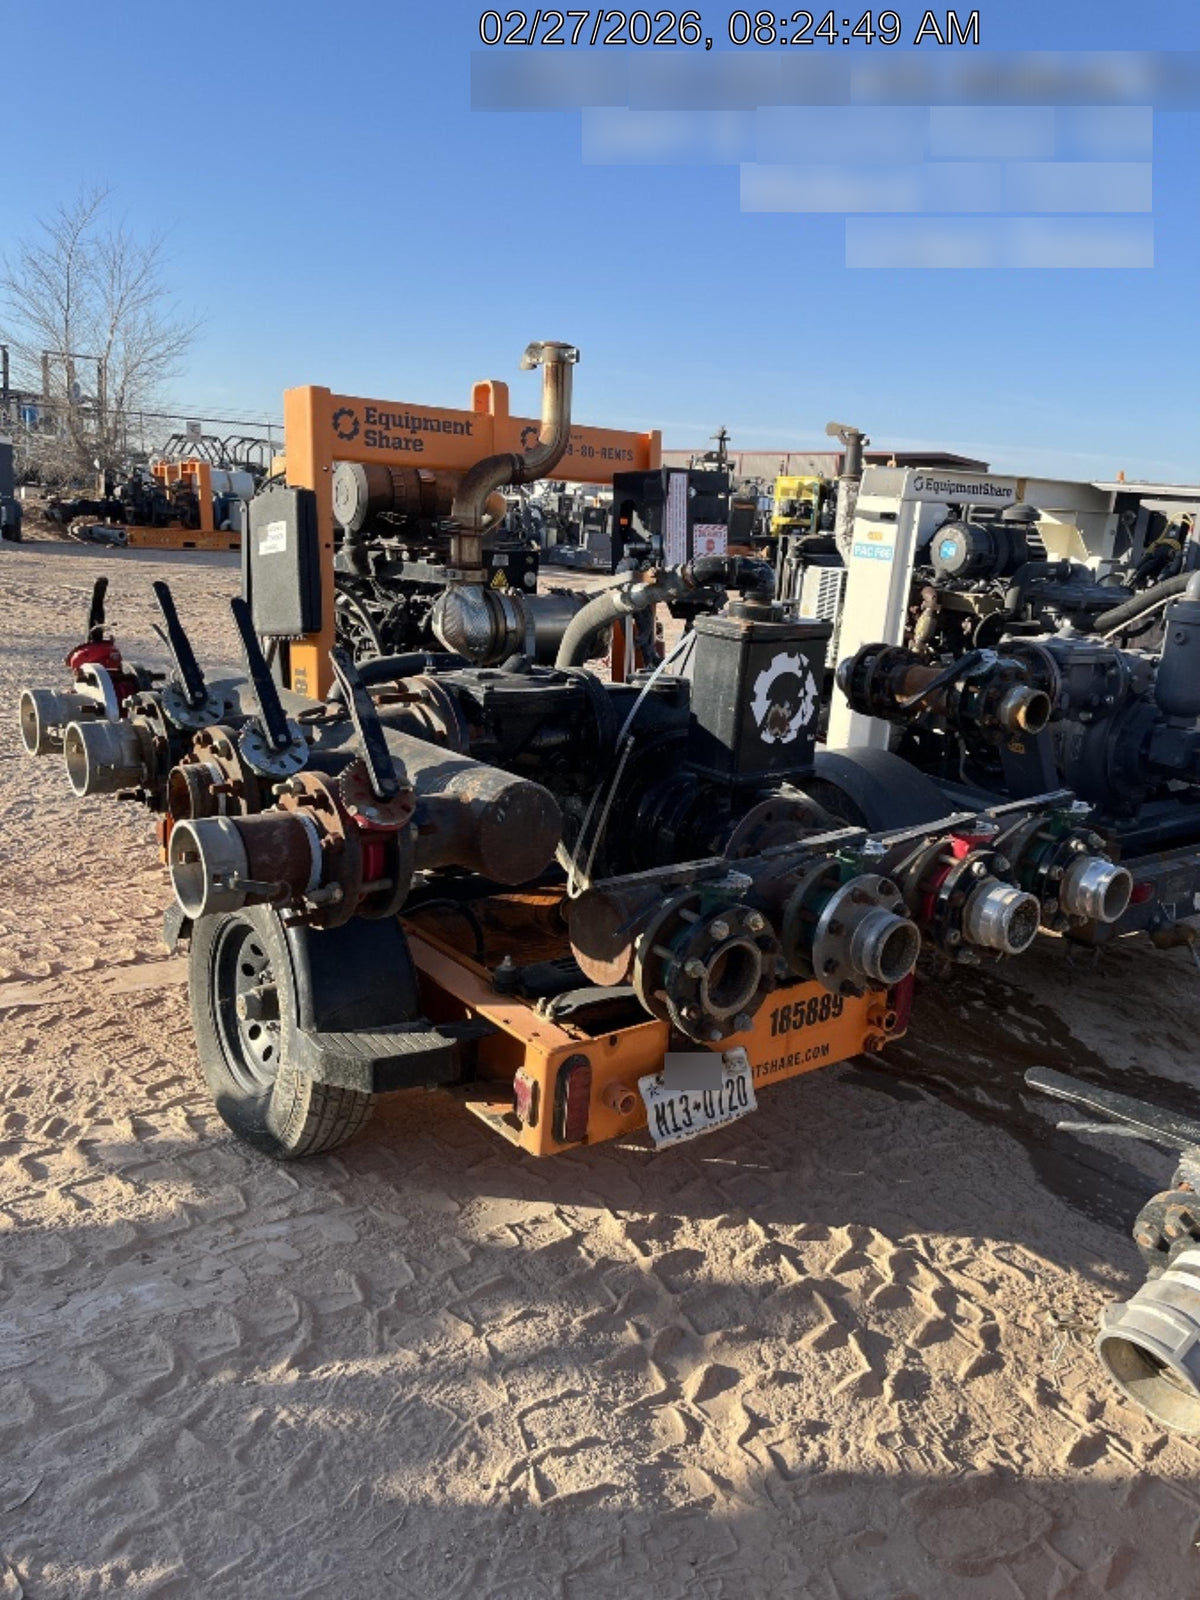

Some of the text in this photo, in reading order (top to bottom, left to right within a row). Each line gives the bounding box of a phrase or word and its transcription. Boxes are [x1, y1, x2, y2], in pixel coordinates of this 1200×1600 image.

[364, 406, 474, 436] Equipment
[363, 429, 424, 452] Share
[925, 477, 1013, 498] EquipmentShare
[769, 993, 844, 1037] 185889
